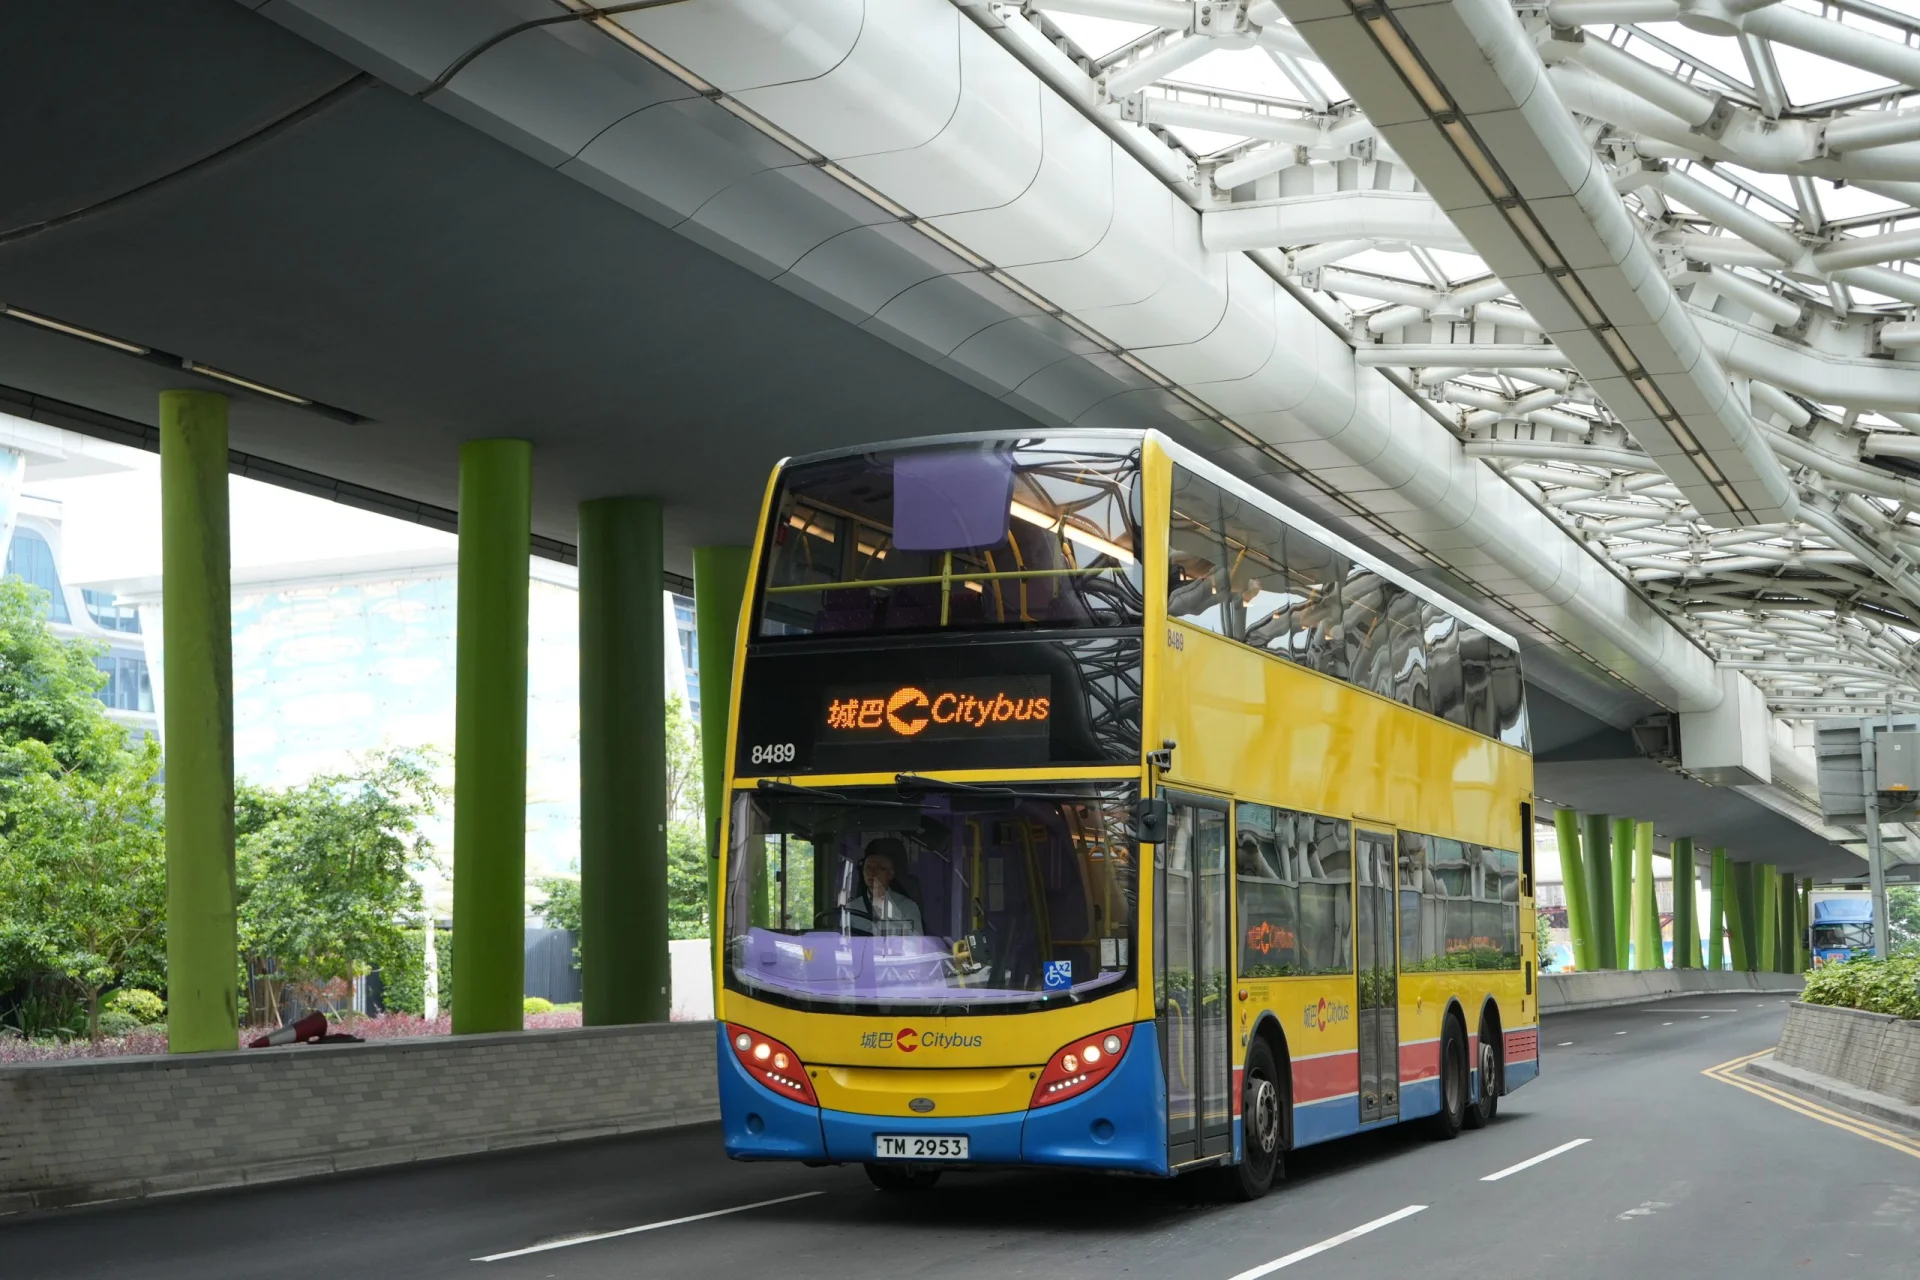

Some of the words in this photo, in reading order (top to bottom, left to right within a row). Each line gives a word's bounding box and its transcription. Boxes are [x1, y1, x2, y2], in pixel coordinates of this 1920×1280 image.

[1167, 628, 1184, 652] 8489
[827, 698, 884, 728] 城巴
[931, 692, 1050, 727] Citybus
[751, 743, 796, 764] 8489
[861, 1031, 893, 1049] 城巴
[921, 1031, 983, 1049] Citybus
[883, 1138, 906, 1155] TM
[914, 1139, 962, 1156] 2953
